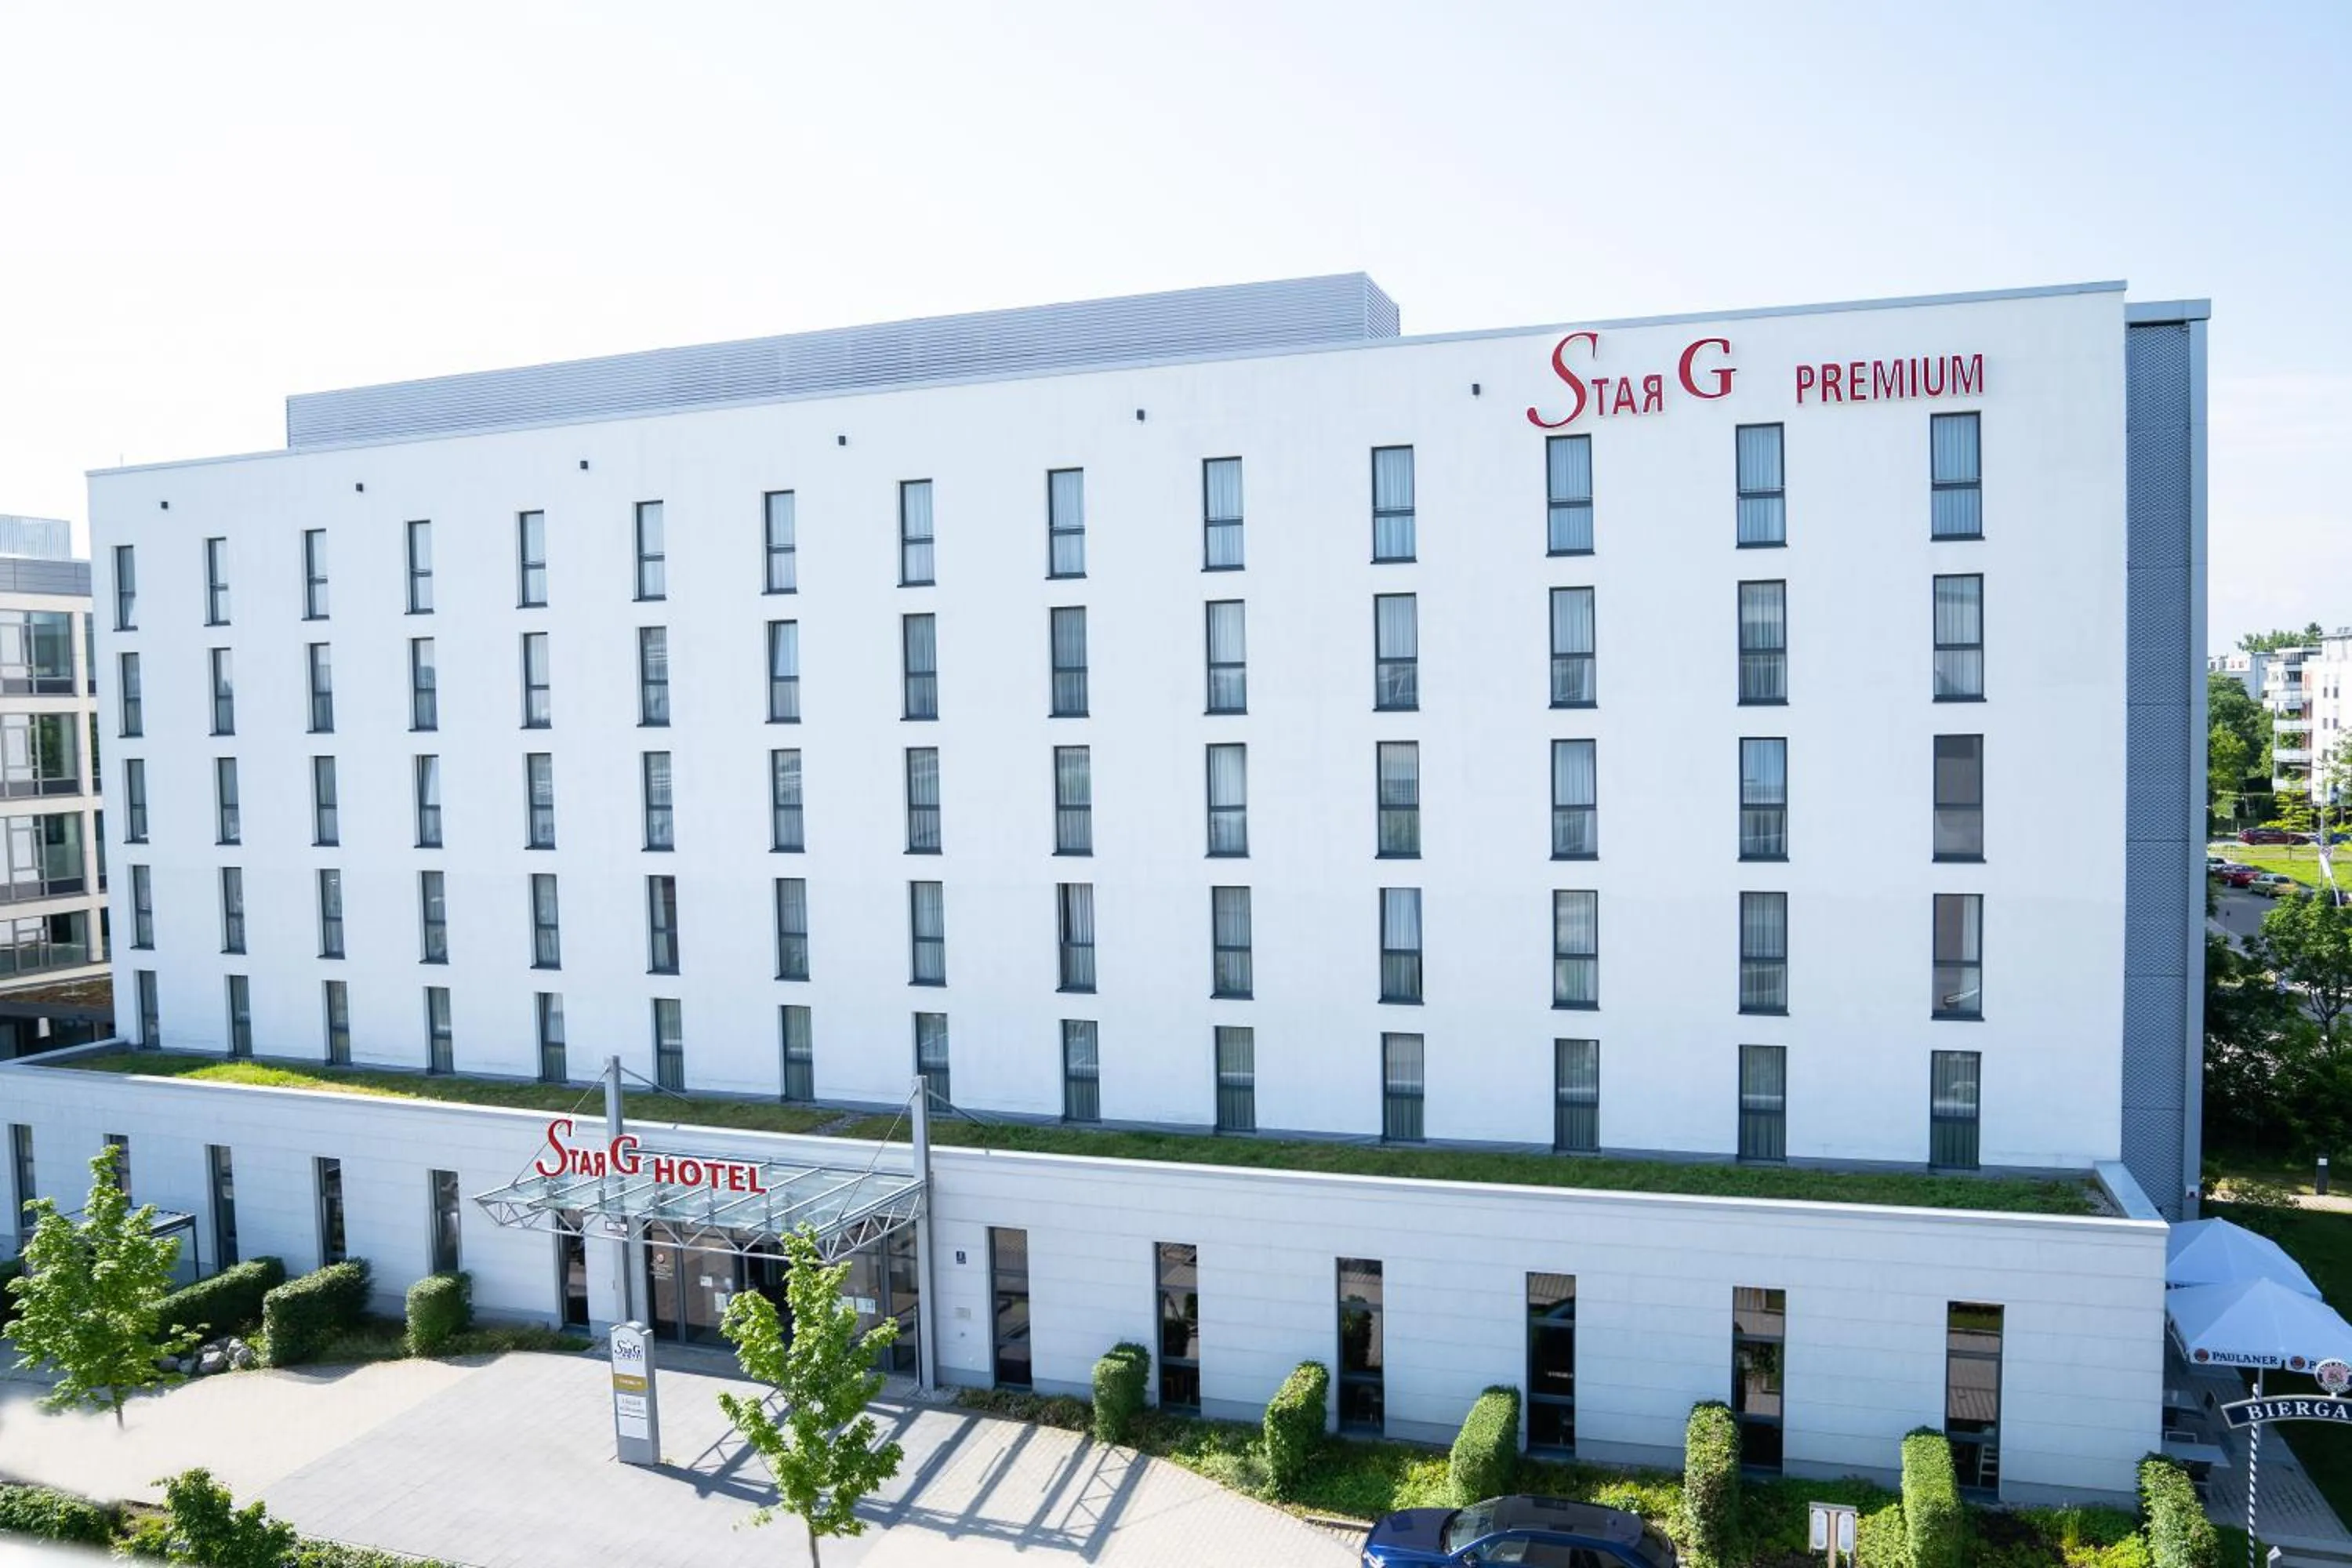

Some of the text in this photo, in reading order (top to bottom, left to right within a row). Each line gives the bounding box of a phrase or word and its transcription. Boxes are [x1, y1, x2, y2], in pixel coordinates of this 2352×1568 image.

[1796, 354, 1983, 403] PREMIUM
[654, 1158, 768, 1194] HOTEL
[2212, 1351, 2278, 1365] PAULANER
